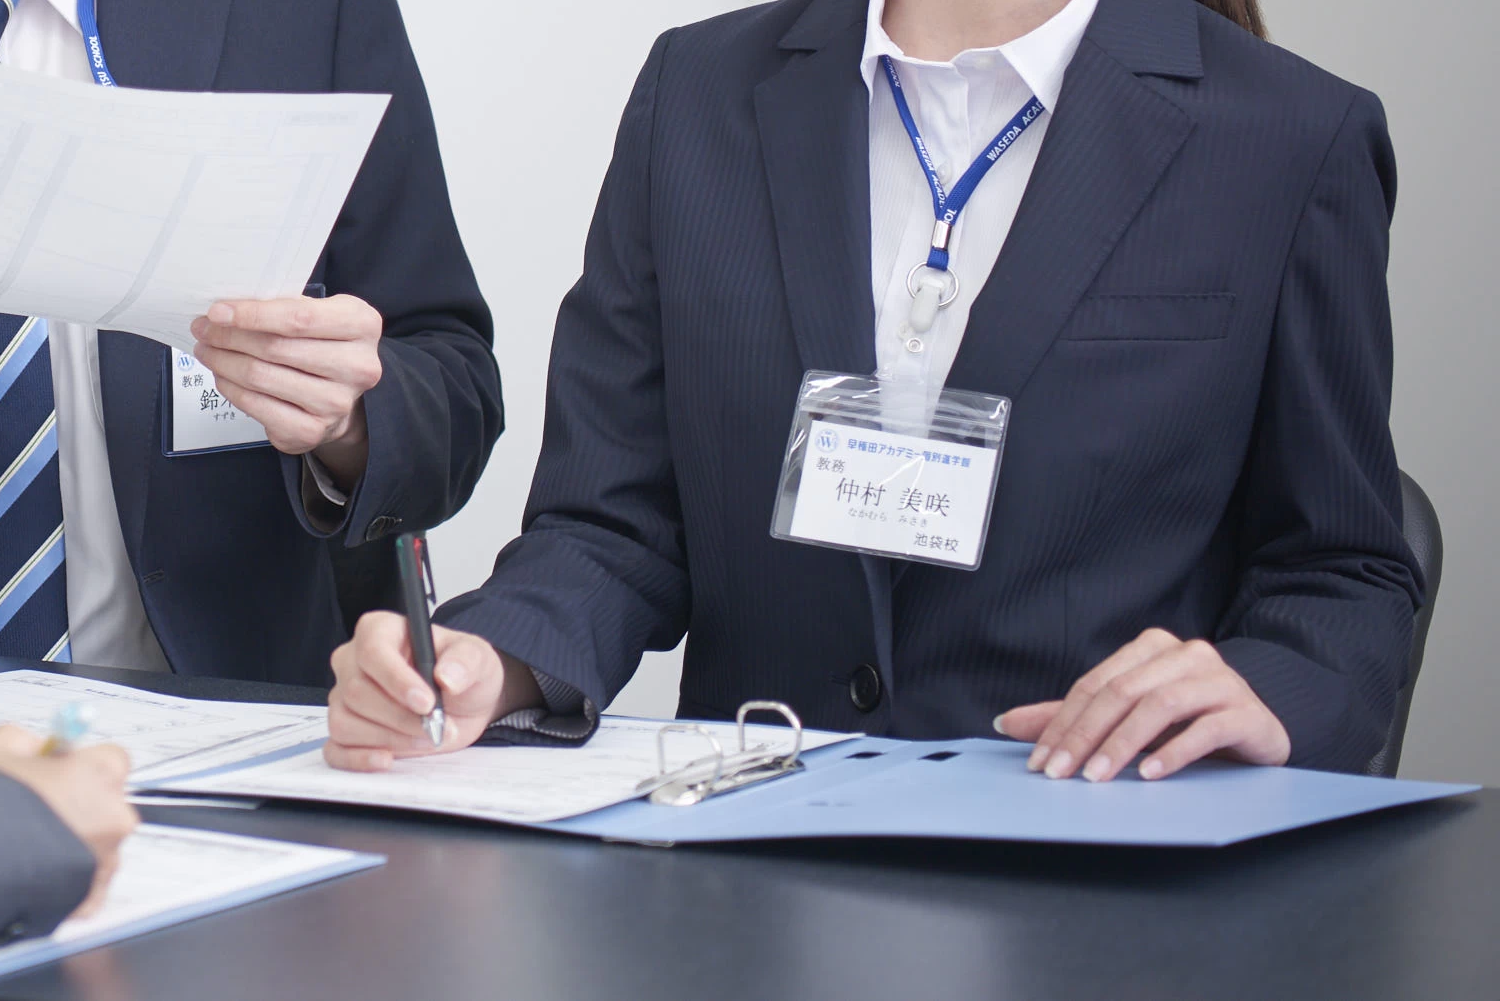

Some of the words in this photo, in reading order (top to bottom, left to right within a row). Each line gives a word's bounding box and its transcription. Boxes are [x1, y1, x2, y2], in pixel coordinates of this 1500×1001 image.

[89, 35, 104, 69] SCHOOL
[986, 125, 1022, 161] WASEDA
[182, 373, 204, 388] 教務
[816, 456, 846, 474] 教務
[835, 477, 887, 508] 仲村
[897, 487, 951, 518] 美咲
[913, 532, 960, 553] 池袋校
